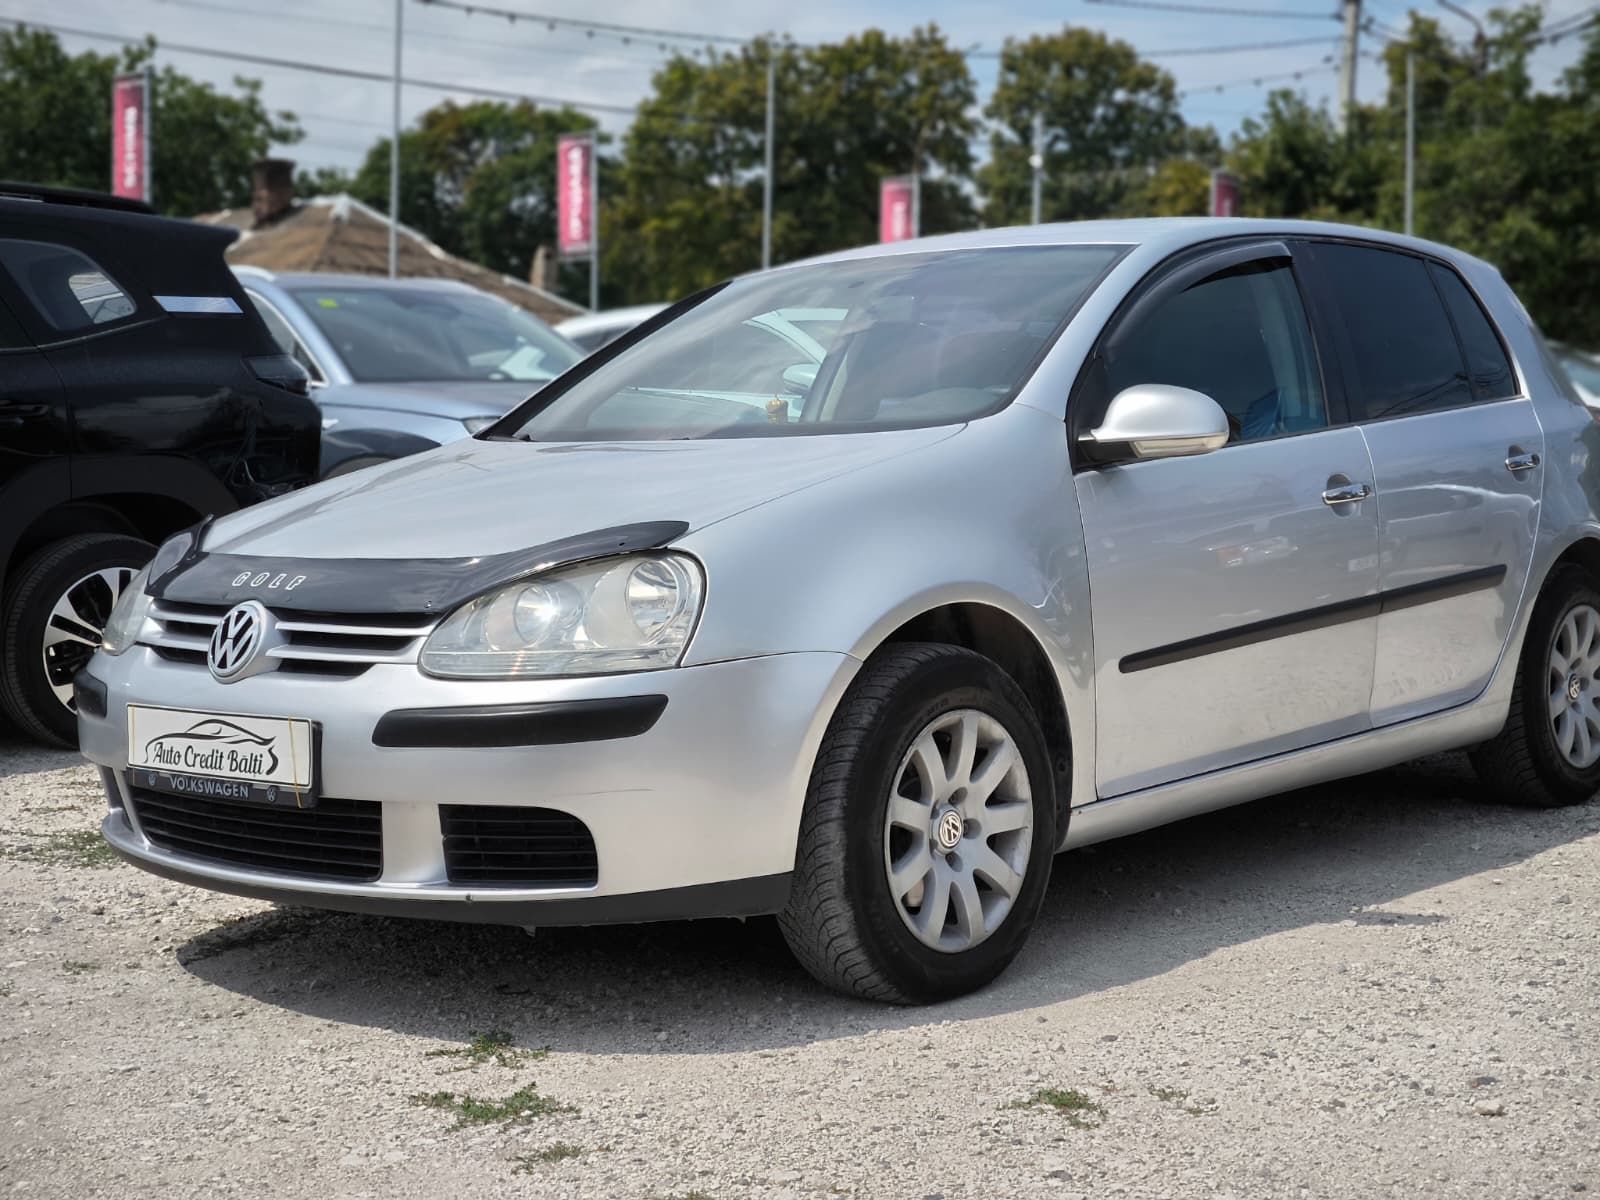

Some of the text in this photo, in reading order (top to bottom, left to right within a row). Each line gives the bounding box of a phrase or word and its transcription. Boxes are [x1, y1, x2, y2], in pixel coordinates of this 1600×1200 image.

[231, 571, 307, 591] GOLF
[209, 602, 264, 682] VW
[153, 742, 181, 766] Auto
[184, 745, 224, 772] Credit
[169, 775, 249, 798] VOLKSWAGEN
